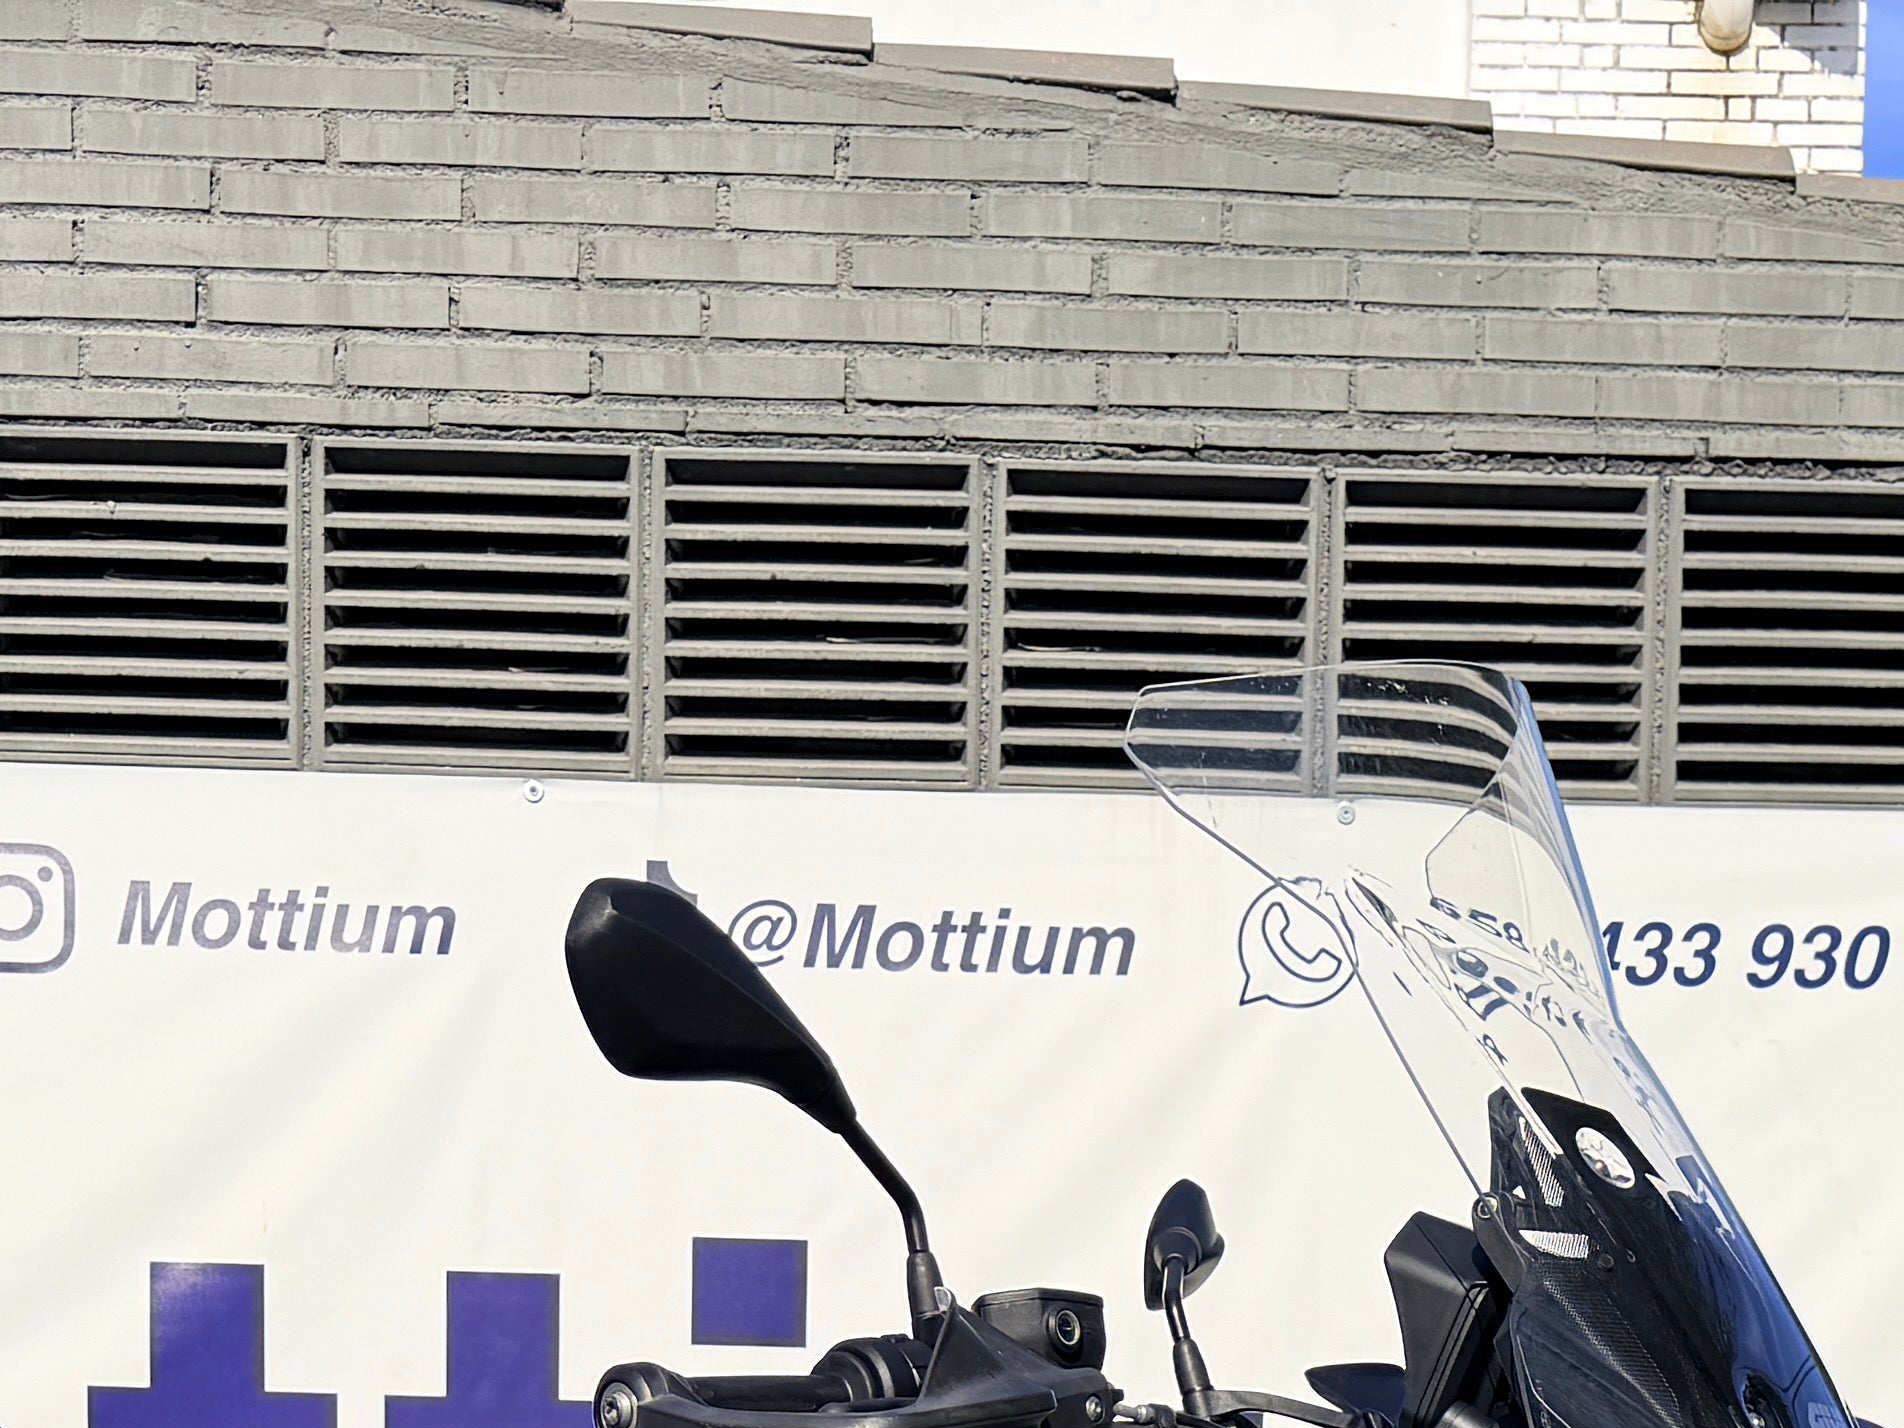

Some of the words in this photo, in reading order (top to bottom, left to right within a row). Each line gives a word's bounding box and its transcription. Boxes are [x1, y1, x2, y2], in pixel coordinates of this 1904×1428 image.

[117, 880, 457, 956] Mottium
[727, 899, 1137, 976] @Mottium
[1746, 923, 1891, 990] 930
